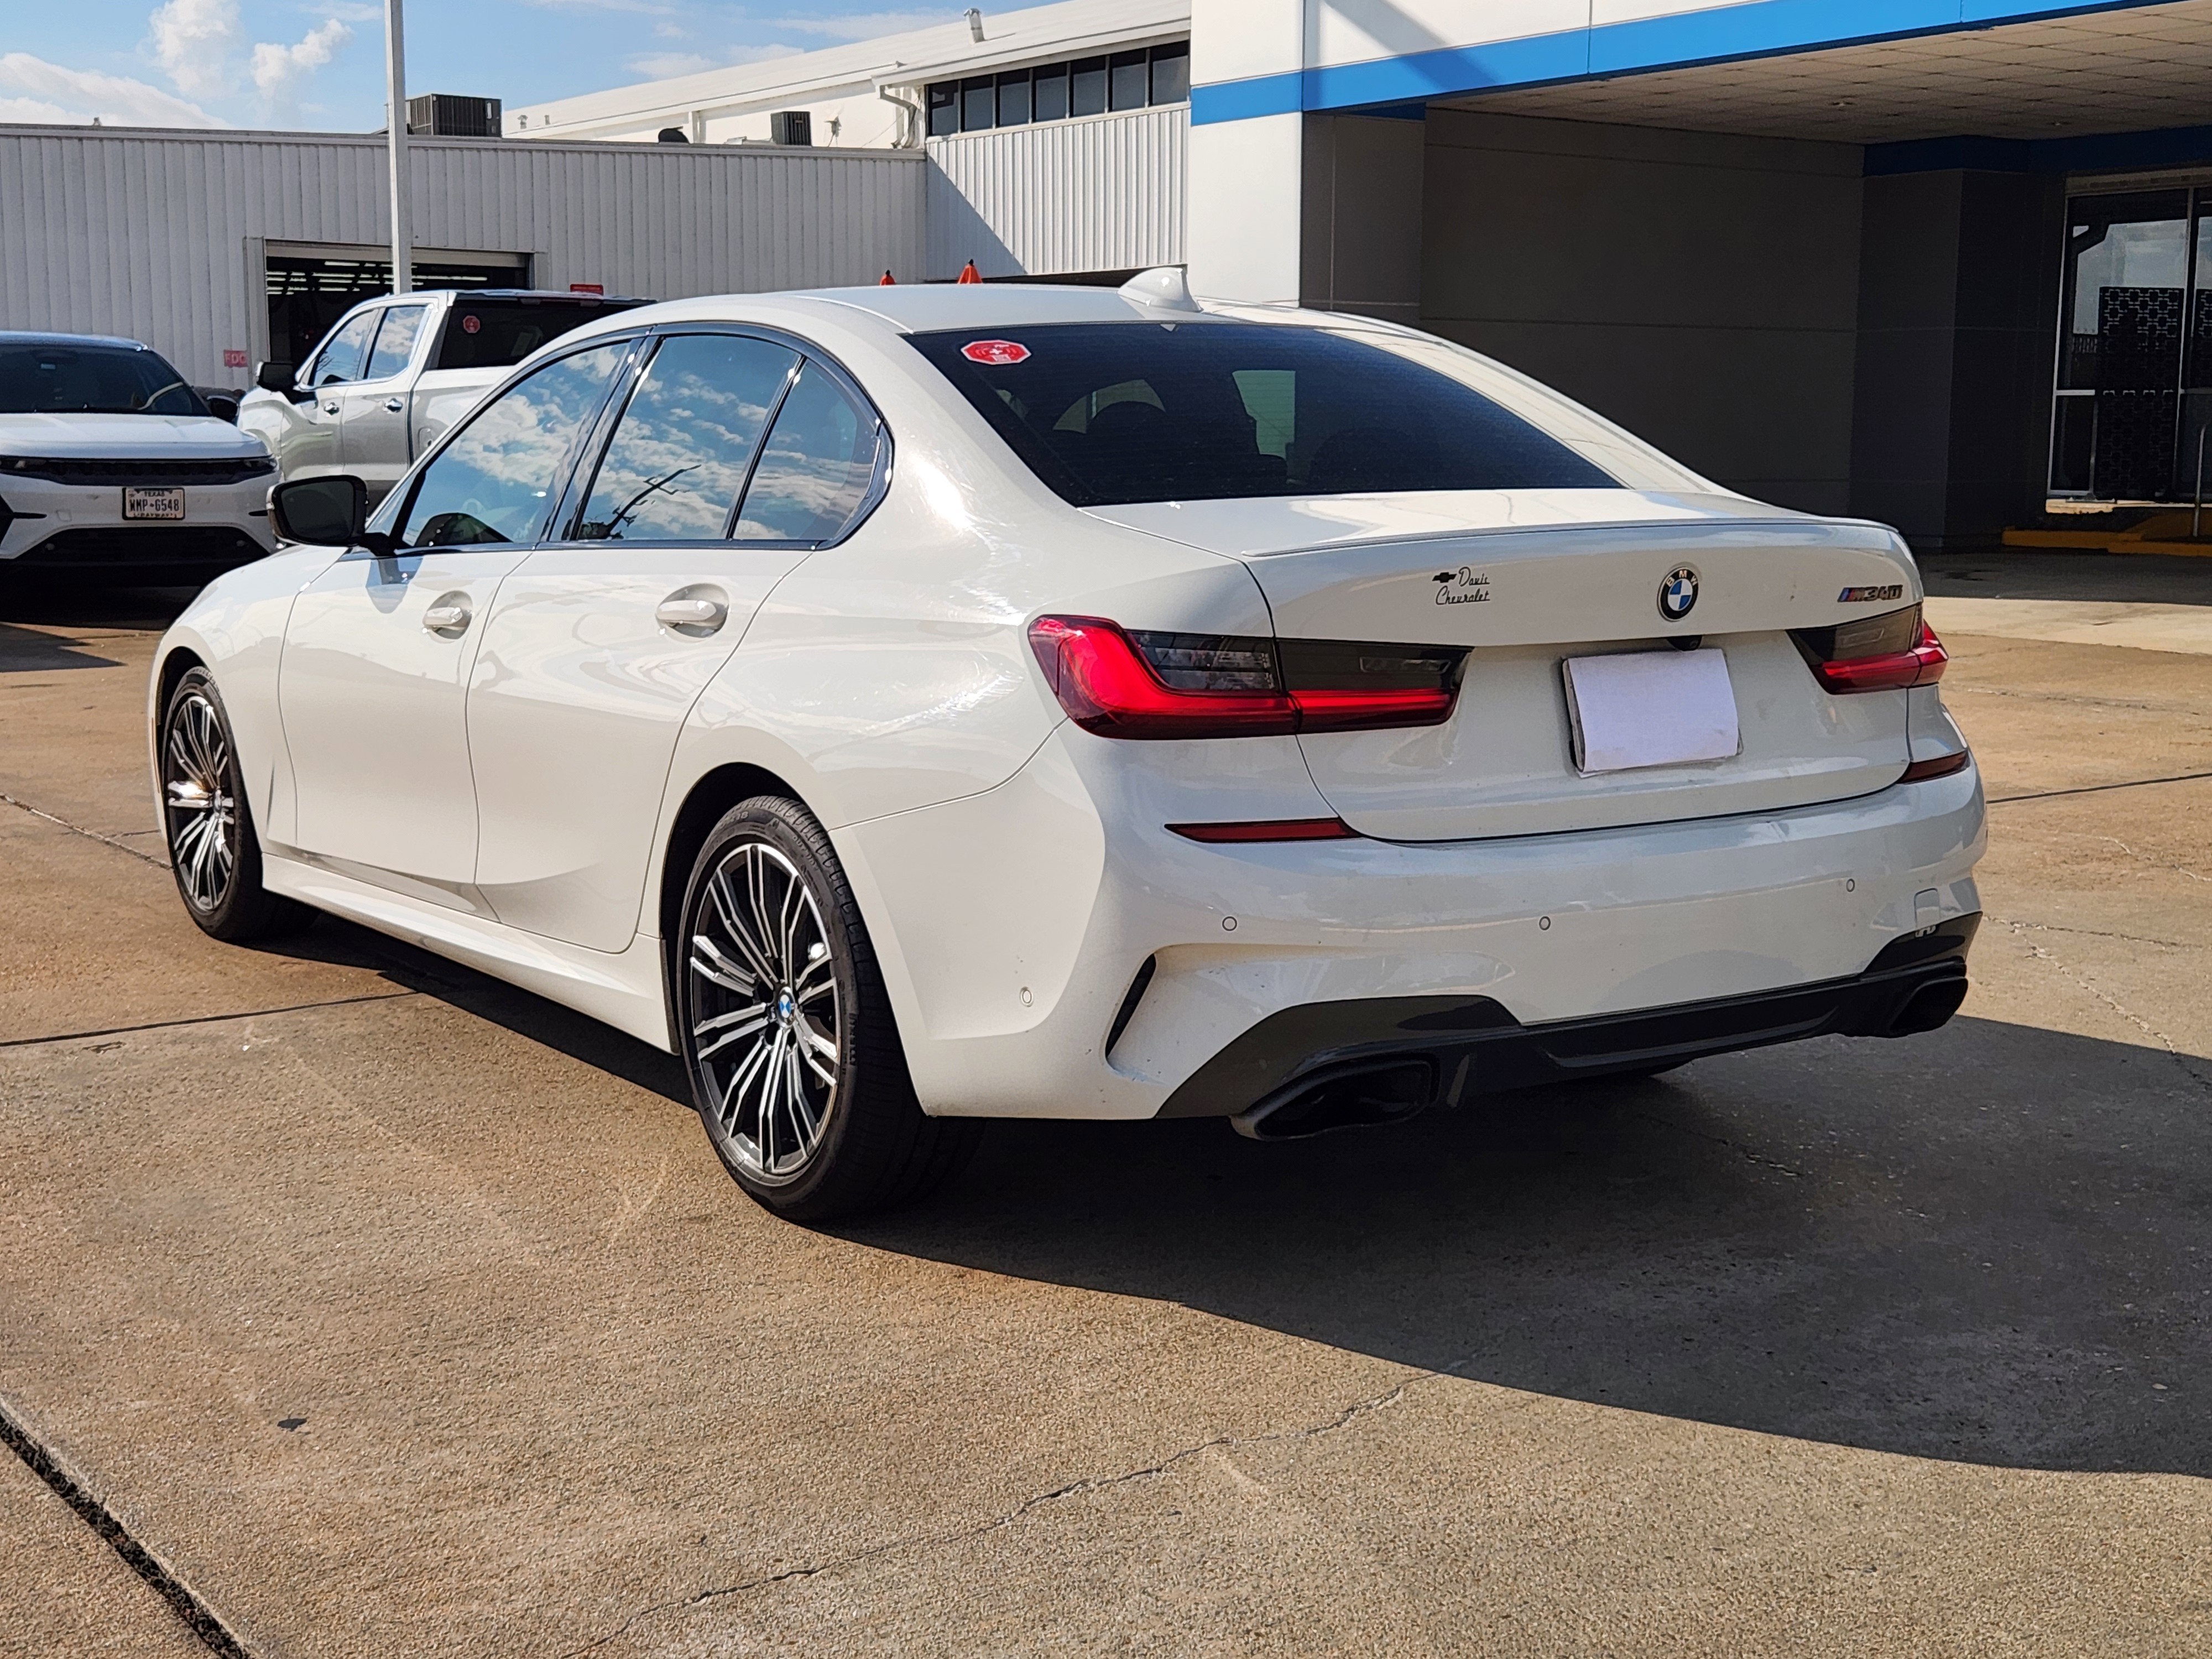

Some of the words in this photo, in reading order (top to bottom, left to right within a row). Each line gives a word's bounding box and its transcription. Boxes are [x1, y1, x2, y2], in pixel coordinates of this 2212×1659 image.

[1459, 566, 1490, 587] Davis
[1666, 570, 1698, 587] BMW
[1436, 585, 1490, 605] Chevrolet
